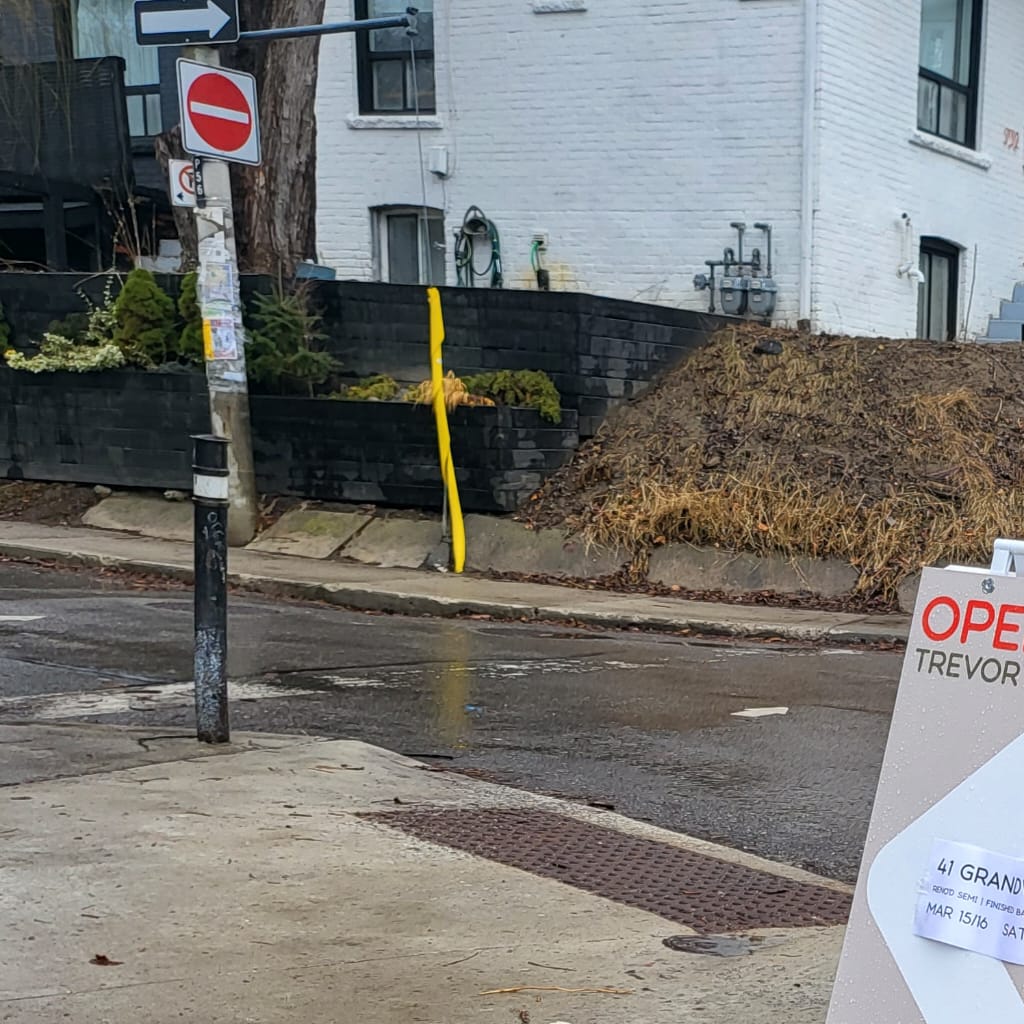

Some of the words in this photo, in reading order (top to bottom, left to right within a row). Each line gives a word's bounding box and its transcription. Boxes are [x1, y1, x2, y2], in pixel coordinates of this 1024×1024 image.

[916, 648, 1021, 687] TREVOR
[937, 858, 955, 876] 41
[957, 891, 979, 904] SEMI
[926, 902, 954, 919] MAR
[959, 910, 988, 930] 15/16
